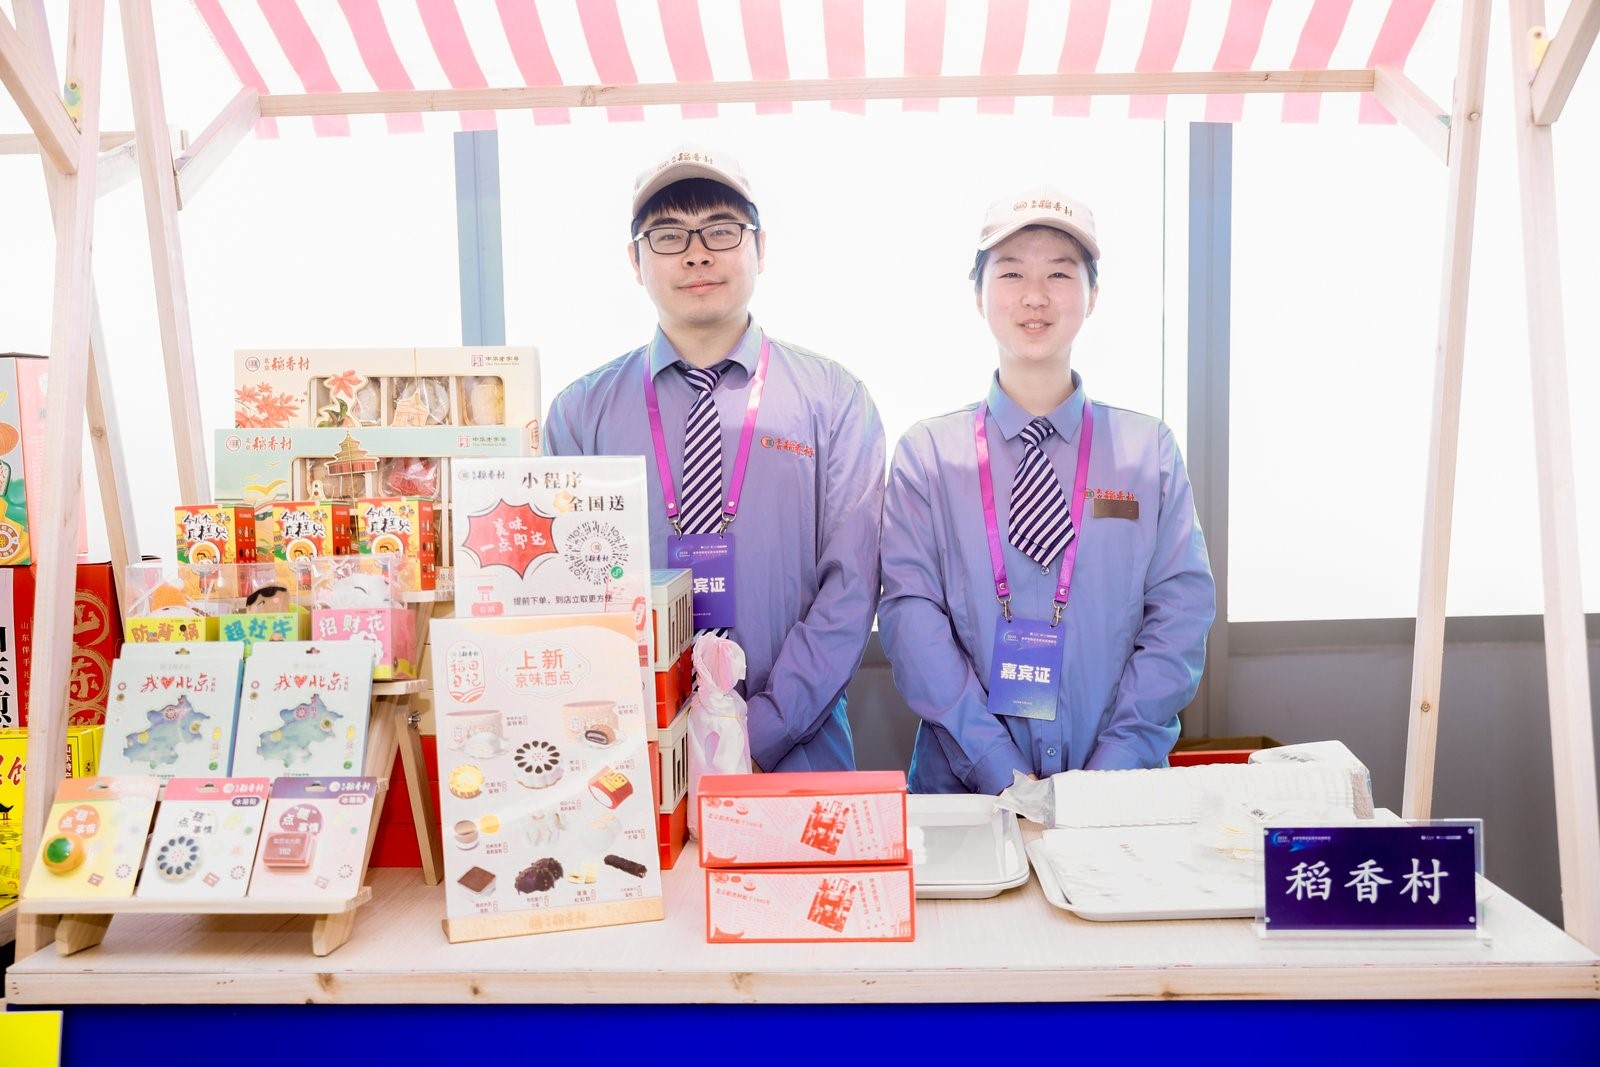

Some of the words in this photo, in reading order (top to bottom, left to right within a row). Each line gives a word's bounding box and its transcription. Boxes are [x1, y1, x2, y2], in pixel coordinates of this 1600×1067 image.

[522, 471, 583, 489] 小程序
[569, 495, 625, 512] 全国送
[492, 516, 528, 537] 美味
[480, 530, 547, 553] 一点即达
[693, 577, 725, 594] 宾证
[224, 617, 292, 641] 超社牛
[319, 614, 385, 637] 招财花
[516, 648, 563, 670] 上新
[514, 671, 573, 688] 京味西点
[1000, 662, 1051, 684] 嘉宾证
[1285, 858, 1449, 904] 稻香村
